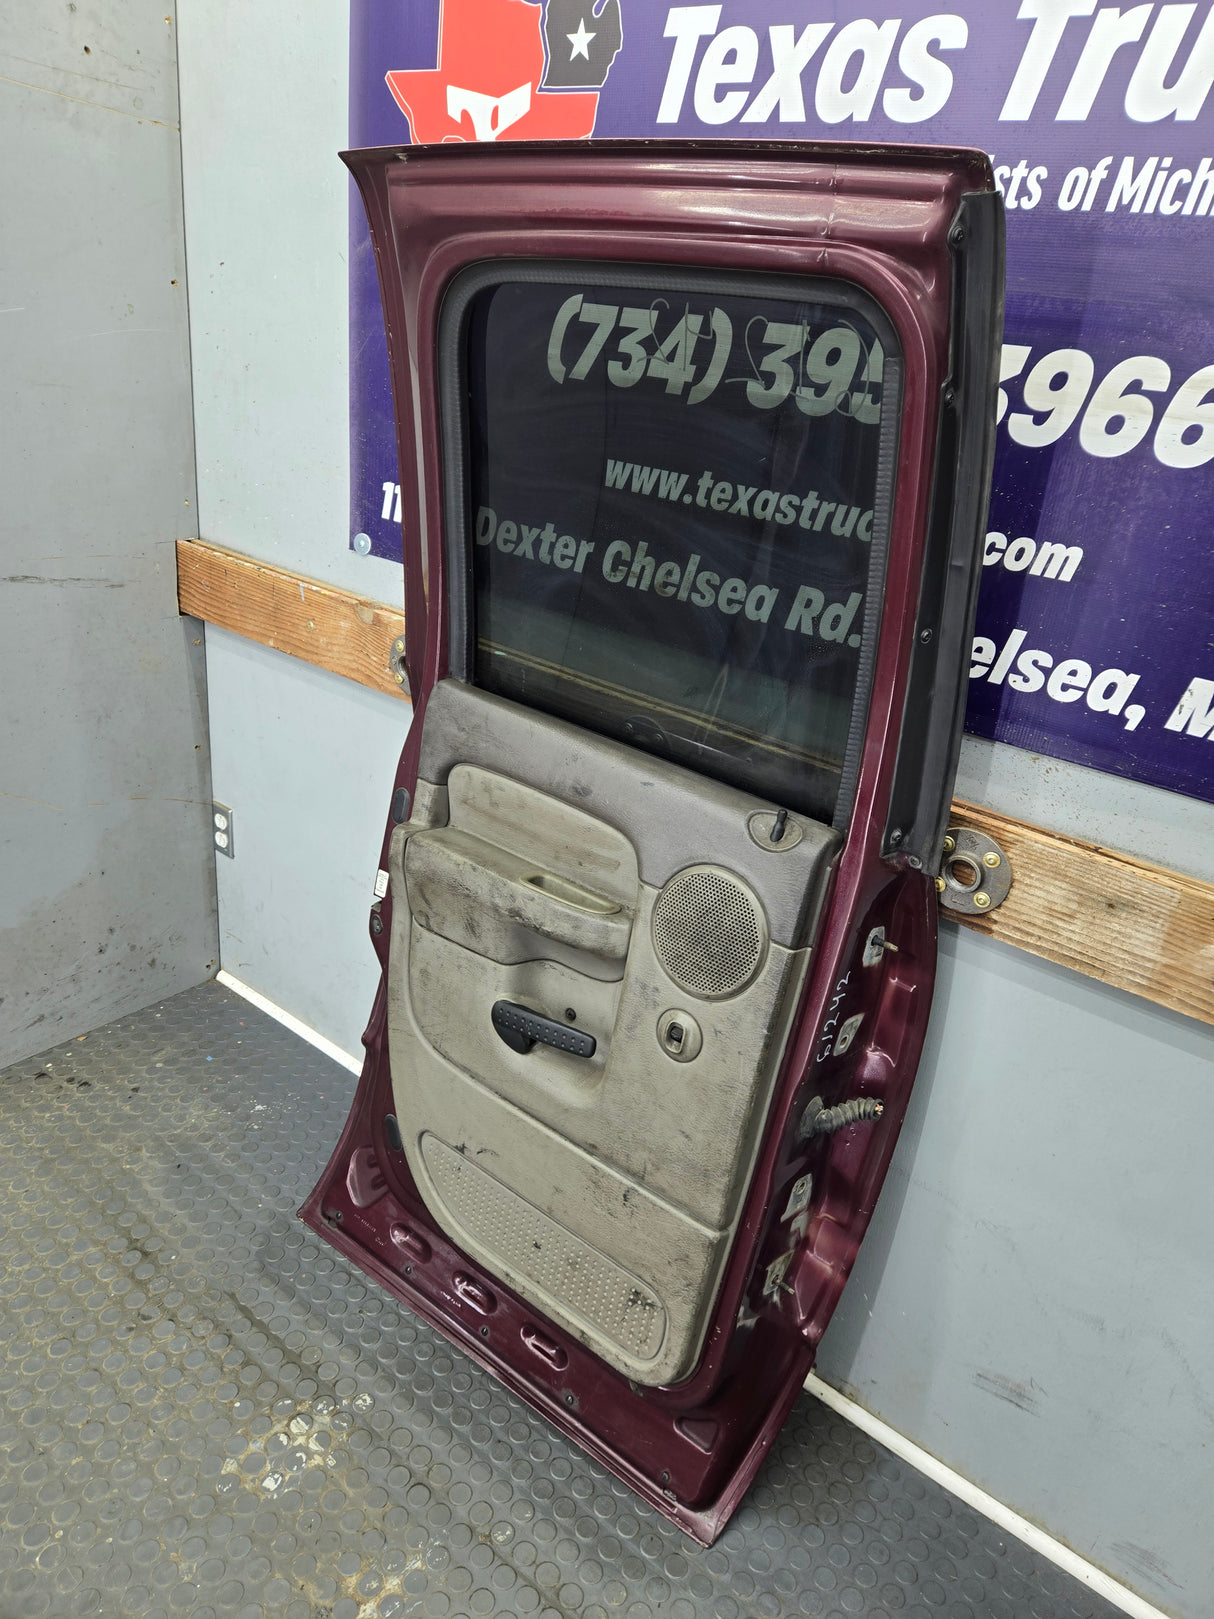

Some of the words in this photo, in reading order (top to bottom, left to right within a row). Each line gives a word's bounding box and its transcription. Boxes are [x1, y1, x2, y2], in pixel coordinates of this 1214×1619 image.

[656, 4, 968, 125] Texas
[998, 0, 1214, 123] Tru
[989, 154, 1048, 210] sts
[1057, 155, 1114, 212] of
[1104, 156, 1214, 217] Mich
[547, 293, 733, 405] (734)
[475, 505, 595, 574] Dexter
[602, 539, 779, 624] Chelsea
[784, 584, 864, 648] Rd.
[816, 970, 851, 1063] 61242
